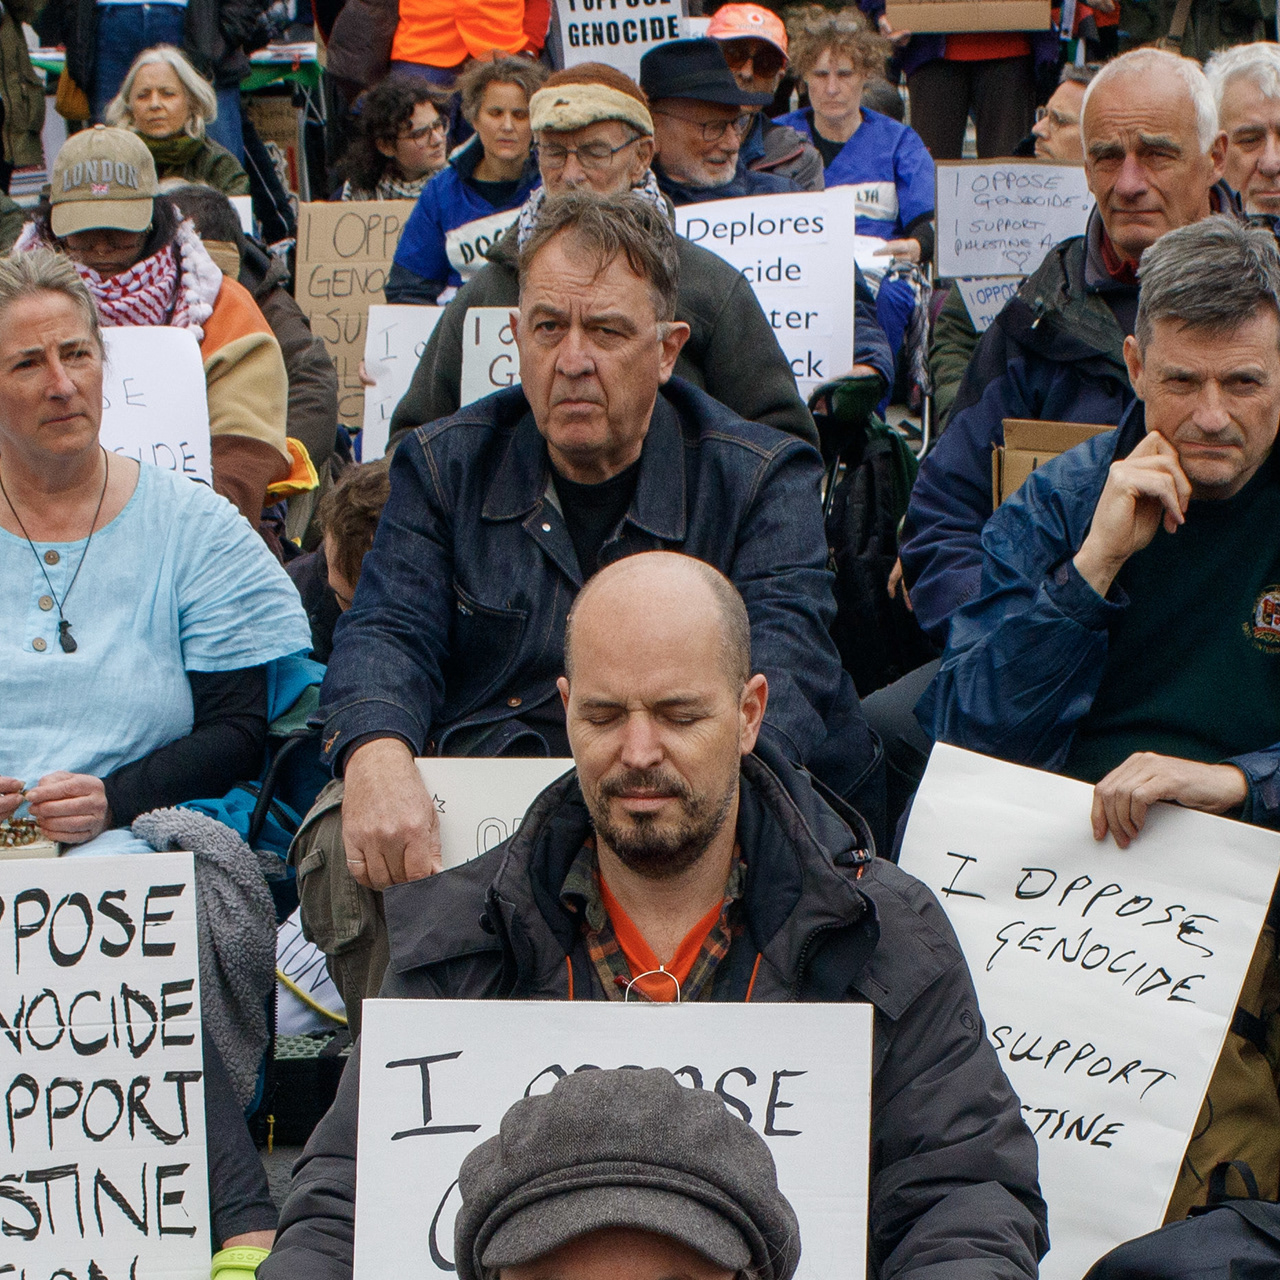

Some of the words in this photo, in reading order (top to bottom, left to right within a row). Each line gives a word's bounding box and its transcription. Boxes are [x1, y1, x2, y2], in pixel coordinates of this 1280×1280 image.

[568, 15, 680, 47] GENOCIDE
[62, 160, 140, 193] LONDON
[954, 172, 960, 198] I
[971, 170, 1063, 194] OPPOSE
[306, 213, 312, 262] I
[332, 212, 404, 259] OPP
[686, 211, 825, 246] Deplores
[954, 218, 959, 237] I
[969, 219, 1046, 234] SUPPORT
[954, 238, 1032, 257] PALESTINE
[741, 256, 802, 285] cide
[378, 322, 399, 362] I
[475, 316, 481, 346] I
[941, 851, 987, 900] I
[1015, 867, 1220, 958] OPPOSE
[986, 920, 1206, 1004] GENOCIDE
[991, 1025, 1177, 1102] SUPPORT
[385, 1050, 482, 1141] I
